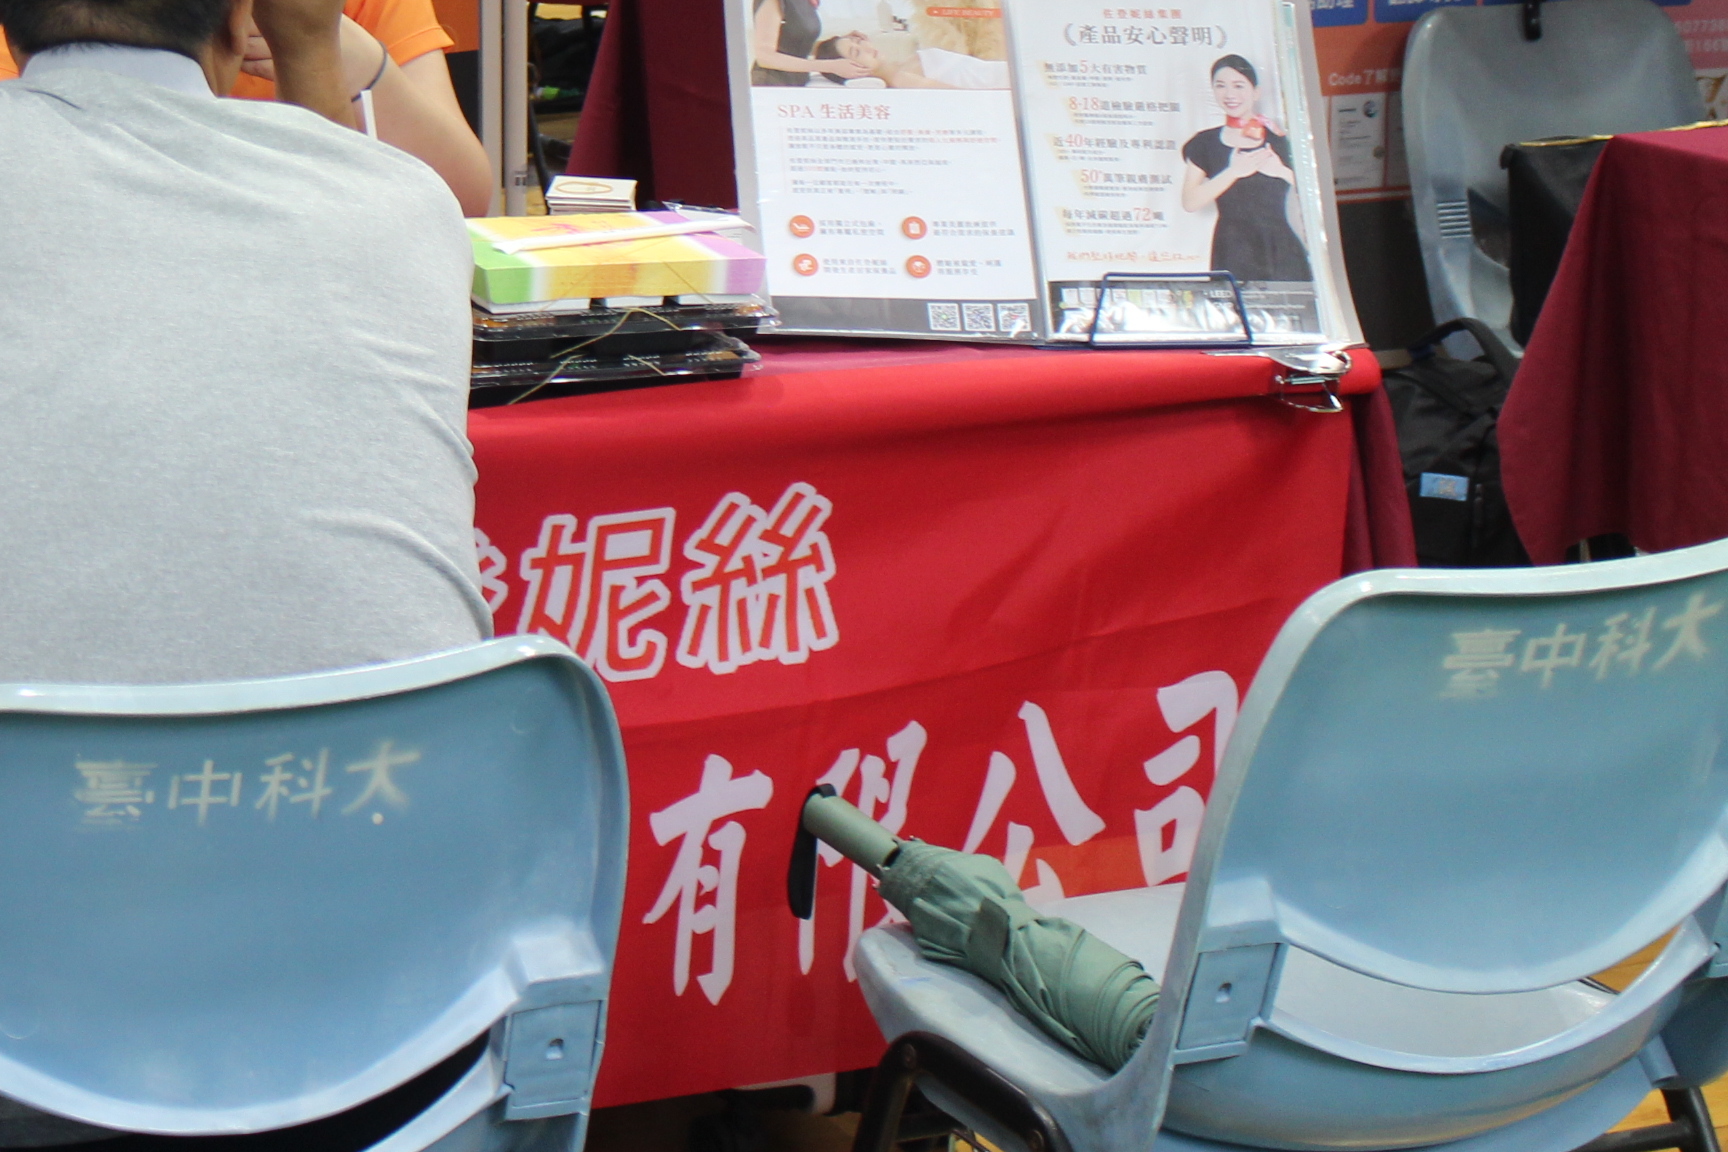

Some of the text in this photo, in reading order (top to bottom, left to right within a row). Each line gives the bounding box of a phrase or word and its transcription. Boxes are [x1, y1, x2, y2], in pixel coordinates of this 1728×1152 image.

[777, 103, 892, 121] SPA 生活美容
[472, 481, 840, 683] 妮絲
[1436, 592, 1727, 700] 臺中科大
[75, 738, 422, 832] 臺中科大
